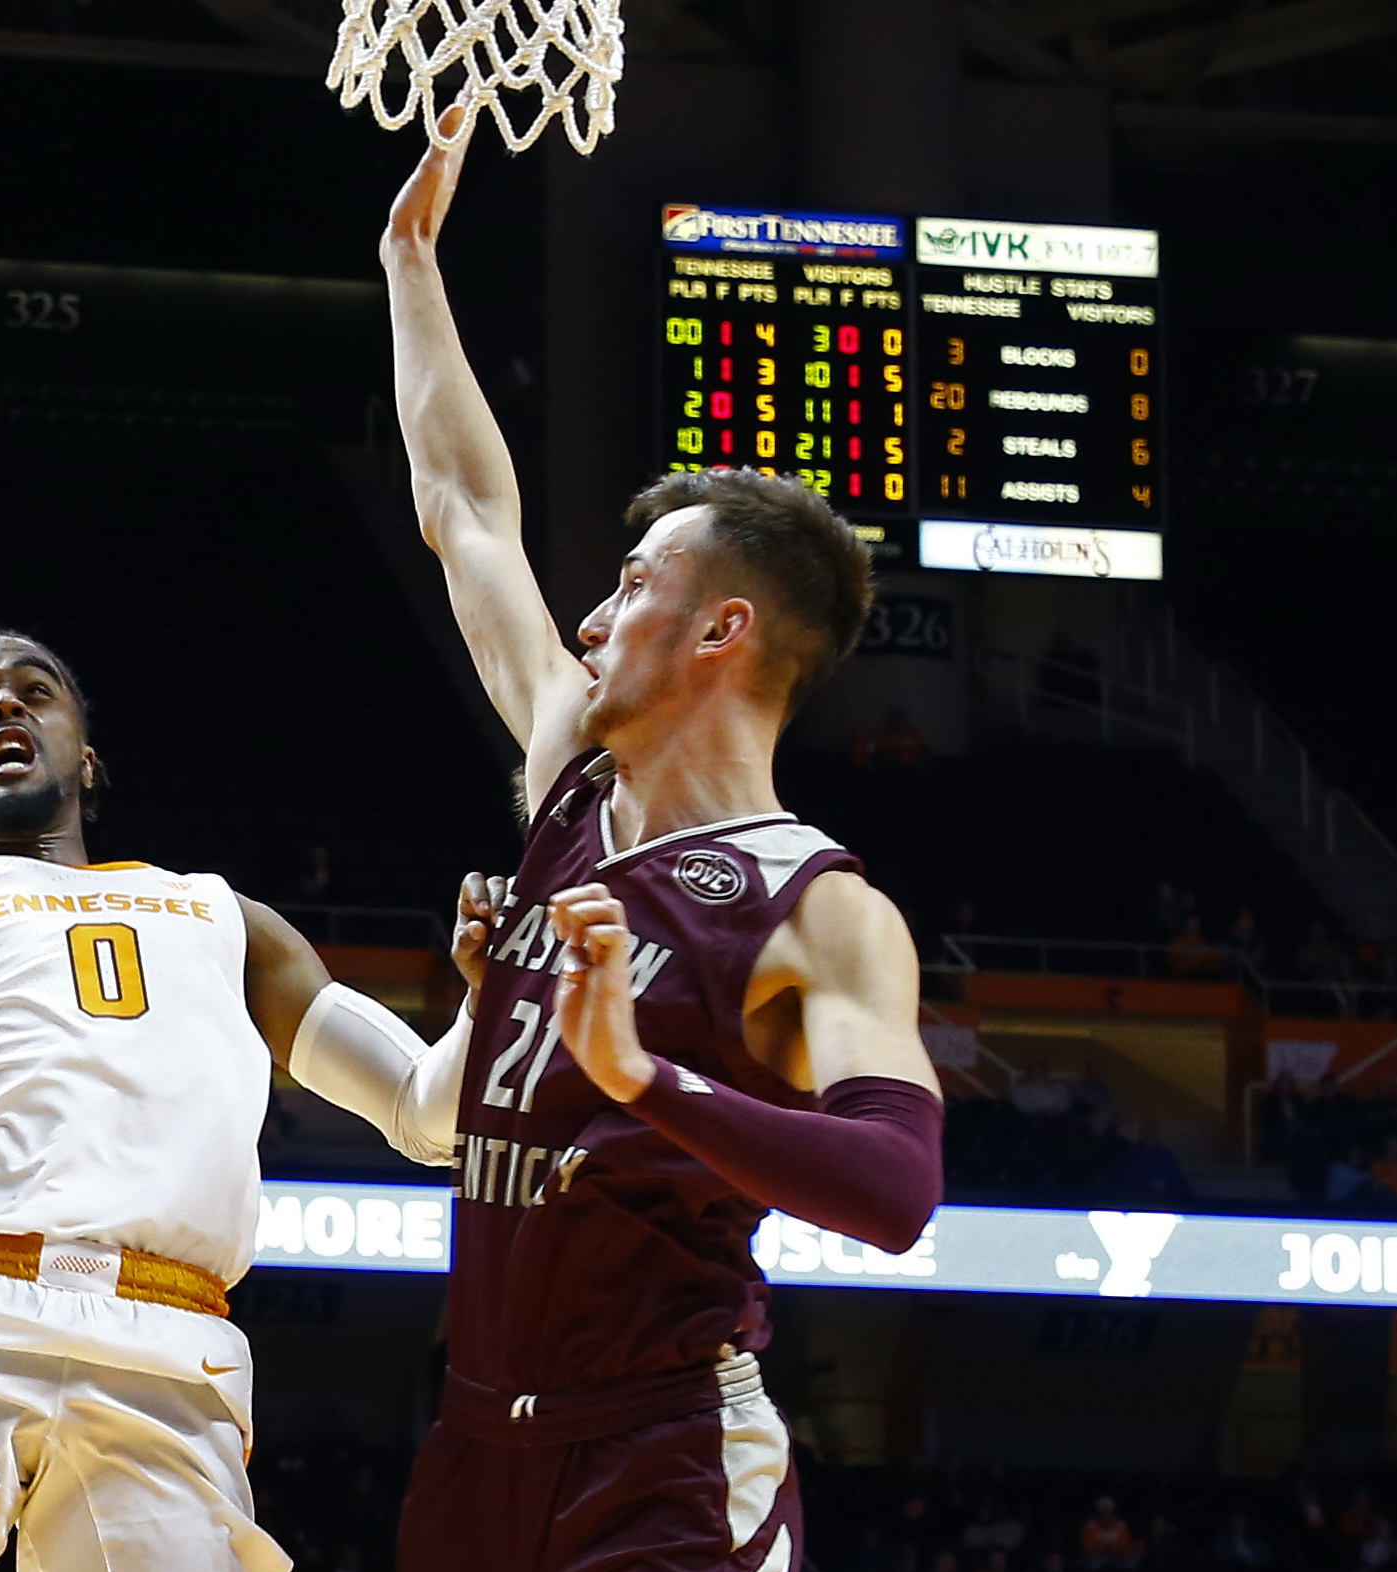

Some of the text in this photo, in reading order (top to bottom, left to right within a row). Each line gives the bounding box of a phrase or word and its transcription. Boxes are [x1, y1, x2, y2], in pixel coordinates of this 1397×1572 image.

[673, 256, 893, 287] TENNESSEE VISITORS
[963, 272, 1113, 300] HUSTLE STATS
[5, 289, 81, 331] 325
[715, 281, 731, 300] F
[738, 283, 778, 303] PTS
[840, 288, 855, 307] F
[862, 290, 902, 310] PTS
[921, 293, 1155, 326] TENNESSEE VISITORS
[666, 317, 903, 356] 00 1 4 3 0 0
[693, 355, 703, 381] 1
[720, 356, 733, 382] 1
[757, 357, 776, 386] 3
[847, 363, 861, 388] 1
[883, 364, 903, 393] 5
[947, 337, 1149, 376] 3 BLOCKS 0
[930, 381, 1150, 421] 20 REBOUNDS 8
[1245, 365, 1319, 405] 327
[683, 390, 904, 427] 2 0 5 11 1 1
[720, 428, 734, 454] 1
[756, 430, 776, 458] 0
[795, 432, 832, 460] 21
[848, 436, 862, 461] 1
[884, 437, 904, 465] 5
[946, 427, 1150, 466] 2 STEALS 6
[848, 472, 862, 497] 1
[884, 472, 904, 500] 0
[940, 474, 1152, 508] 11 ASSISTS 4
[863, 602, 949, 650] 326
[685, 861, 733, 892] OVC
[65, 922, 150, 1020] 0
[482, 999, 563, 1114] 21
[255, 1197, 445, 1260] MORE
